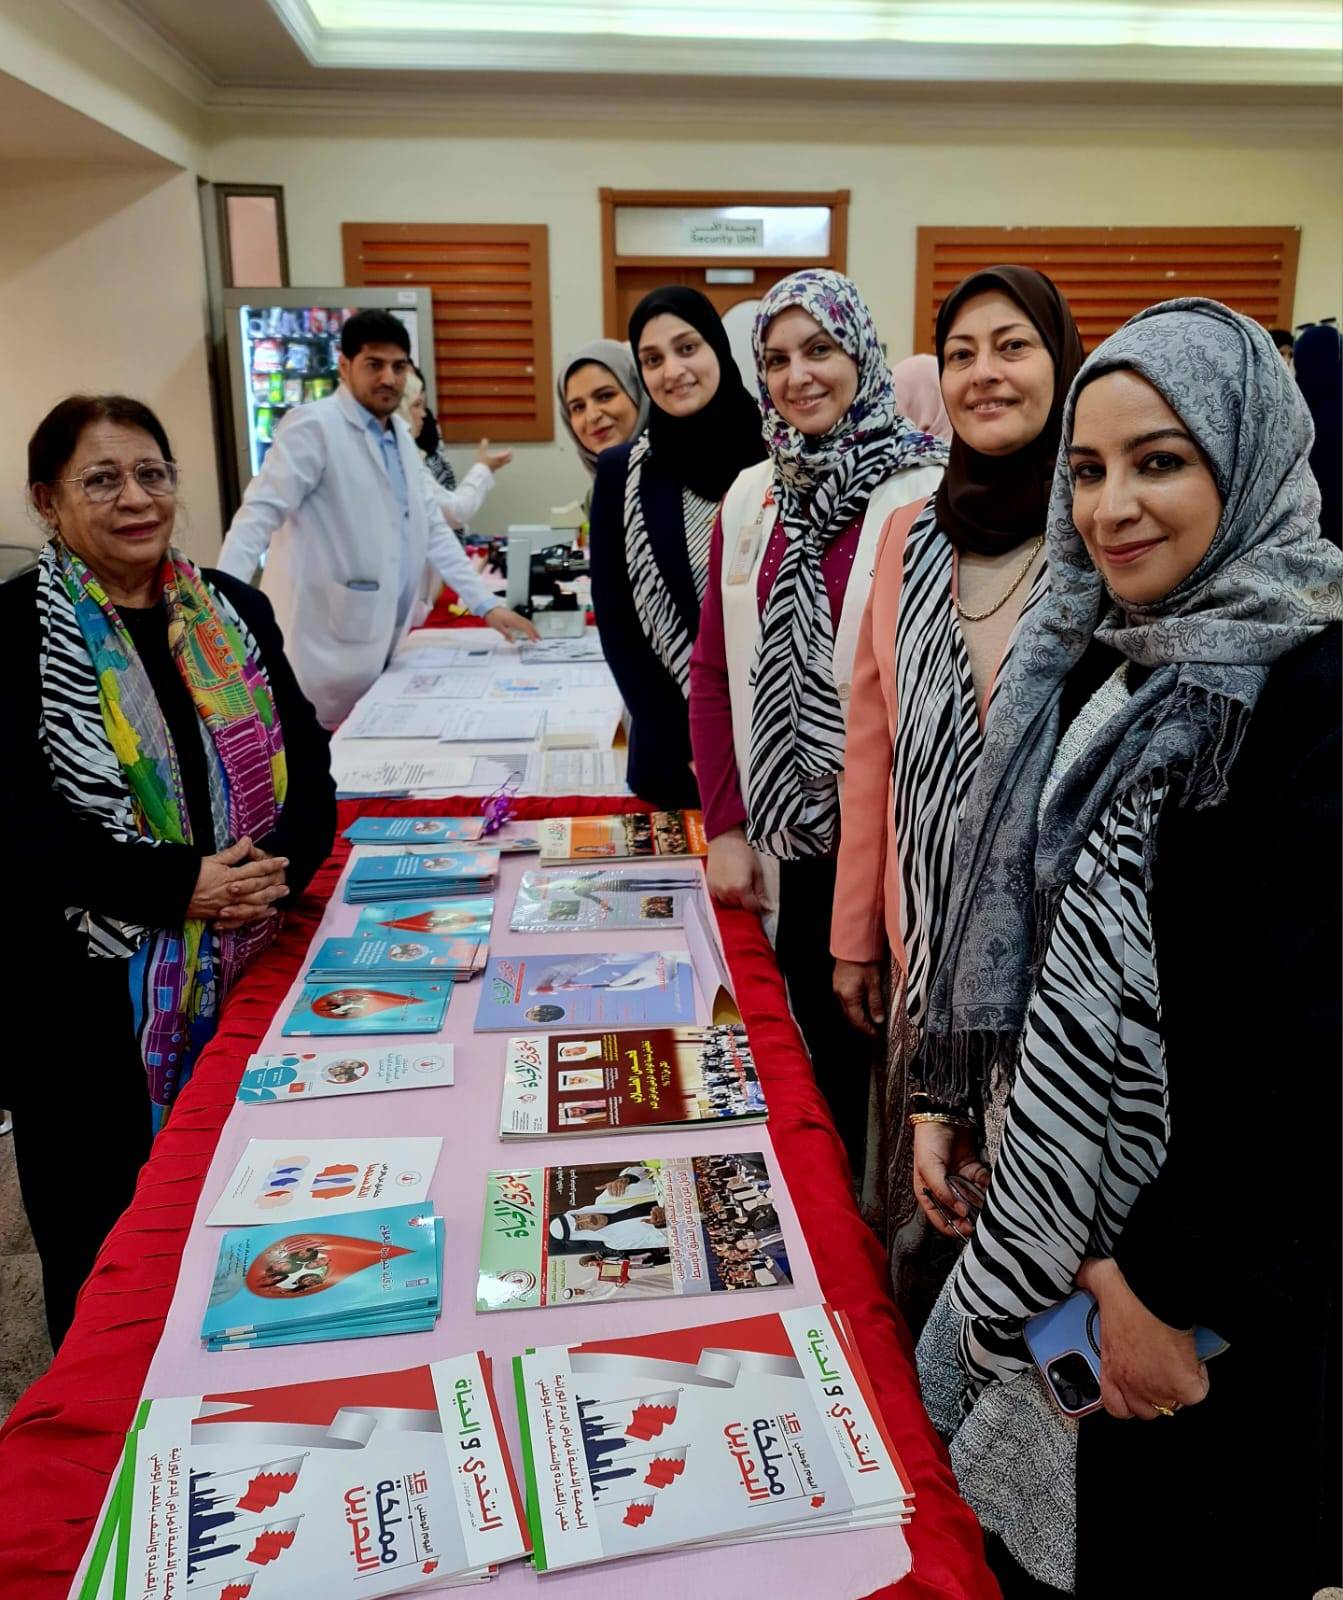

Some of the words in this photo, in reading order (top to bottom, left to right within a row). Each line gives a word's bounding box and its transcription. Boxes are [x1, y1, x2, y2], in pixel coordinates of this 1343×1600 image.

[691, 233, 732, 244] Security
[737, 233, 756, 243] Unit
[537, 1380, 552, 1407] الوطني
[554, 1375, 567, 1403] الوراثية
[823, 1386, 844, 1396] و
[543, 1409, 555, 1434] بالعيد
[557, 1406, 570, 1422] الدم
[785, 1413, 801, 1433] 16
[460, 1438, 481, 1450] و
[549, 1437, 560, 1471] والشعب
[560, 1425, 578, 1455] لأمراض
[151, 1454, 162, 1483] الوطني
[168, 1448, 181, 1478] الوراثية
[724, 1423, 770, 1500] البحرين
[753, 1419, 785, 1495] مملكة
[793, 1443, 810, 1468] الوطني
[413, 1471, 427, 1494] 16
[567, 1457, 583, 1488] الأهلية
[804, 1470, 818, 1489] اليوم
[150, 1486, 161, 1512] بالعيد
[167, 1480, 178, 1498] الدم
[554, 1473, 567, 1505] القيادة
[165, 1501, 182, 1534] لأمراض
[376, 1480, 402, 1563] مملكة
[415, 1504, 429, 1531] الوطني
[572, 1490, 588, 1530] الجمعية
[146, 1514, 159, 1553] والشعب
[345, 1486, 380, 1571] البحرين
[164, 1536, 180, 1571] الأهلية
[422, 1533, 433, 1553] اليوم
[144, 1555, 159, 1593] القيادة
[164, 1572, 177, 1600] معية
